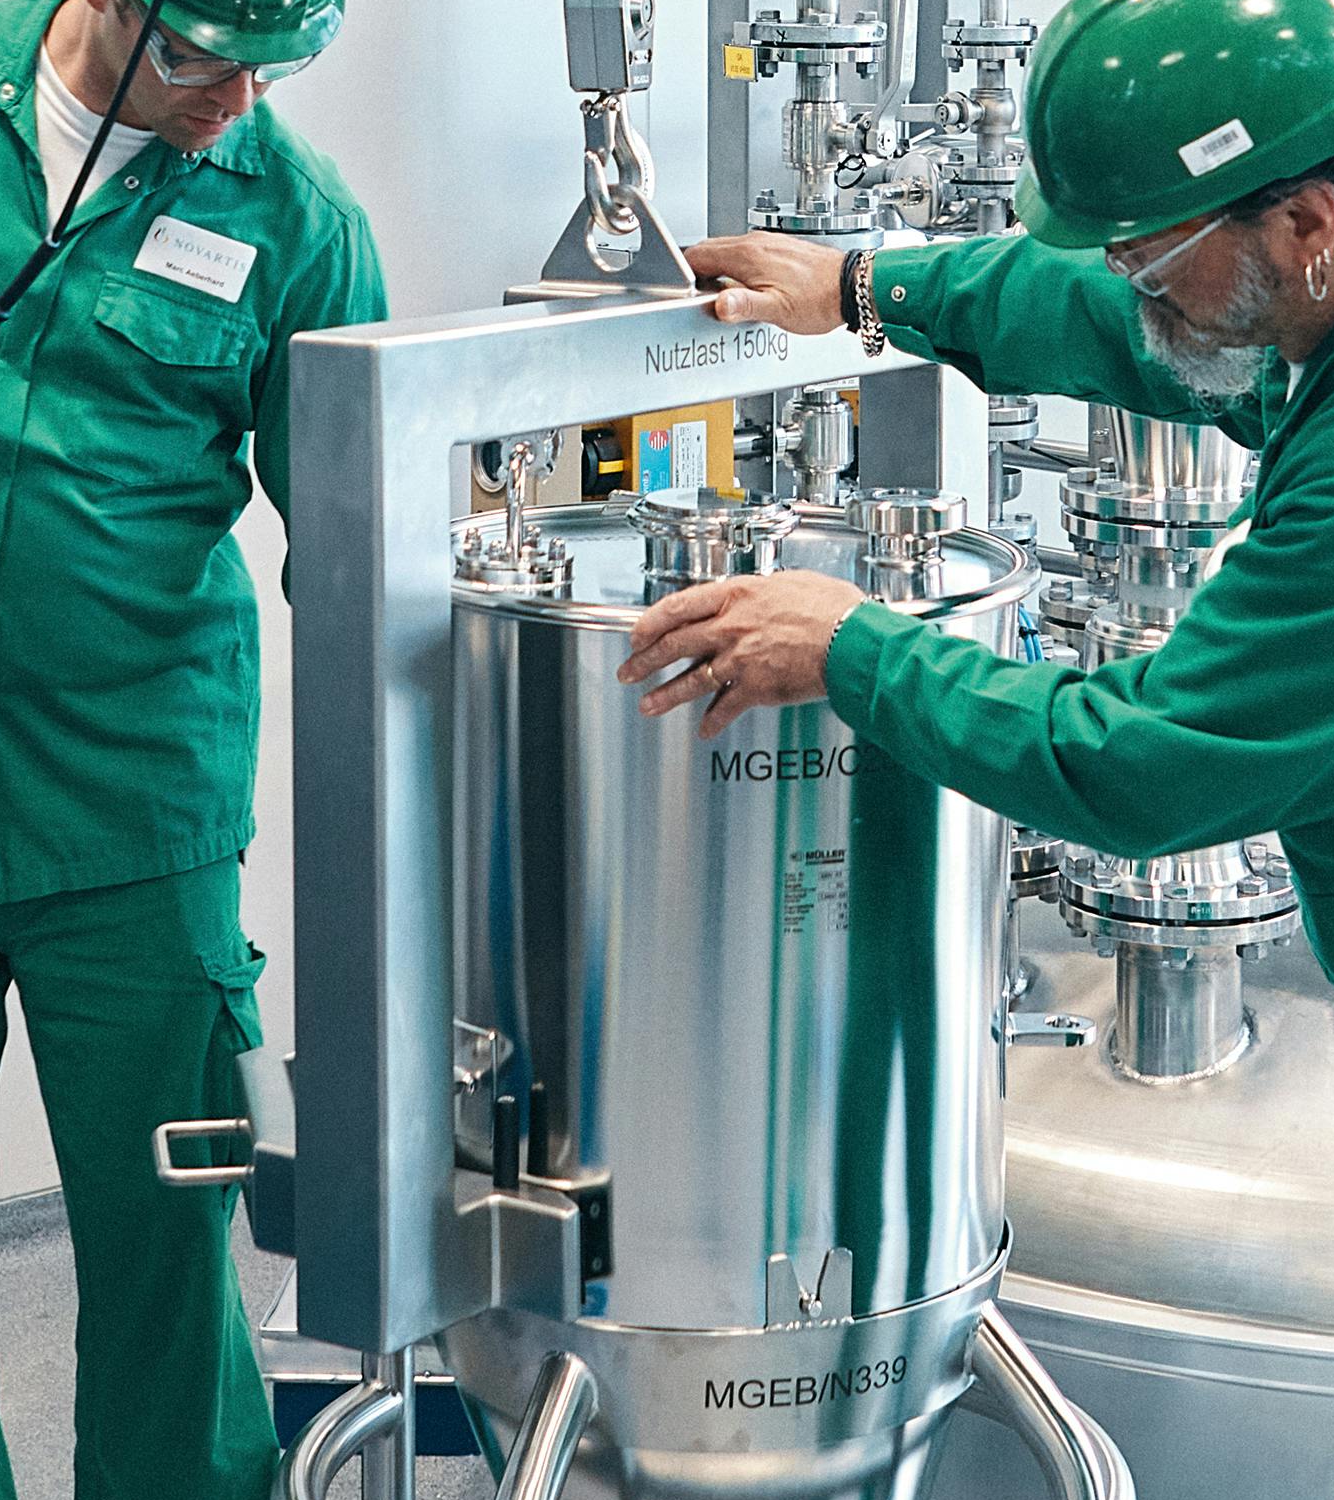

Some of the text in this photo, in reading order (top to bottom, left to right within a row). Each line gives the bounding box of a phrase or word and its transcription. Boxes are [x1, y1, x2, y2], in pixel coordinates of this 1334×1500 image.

[165, 261, 184, 274] Marc
[174, 238, 247, 273] NOVARTIS
[645, 327, 789, 375] Nutzlast 150kg
[704, 1355, 908, 1409] MGEB/N339
